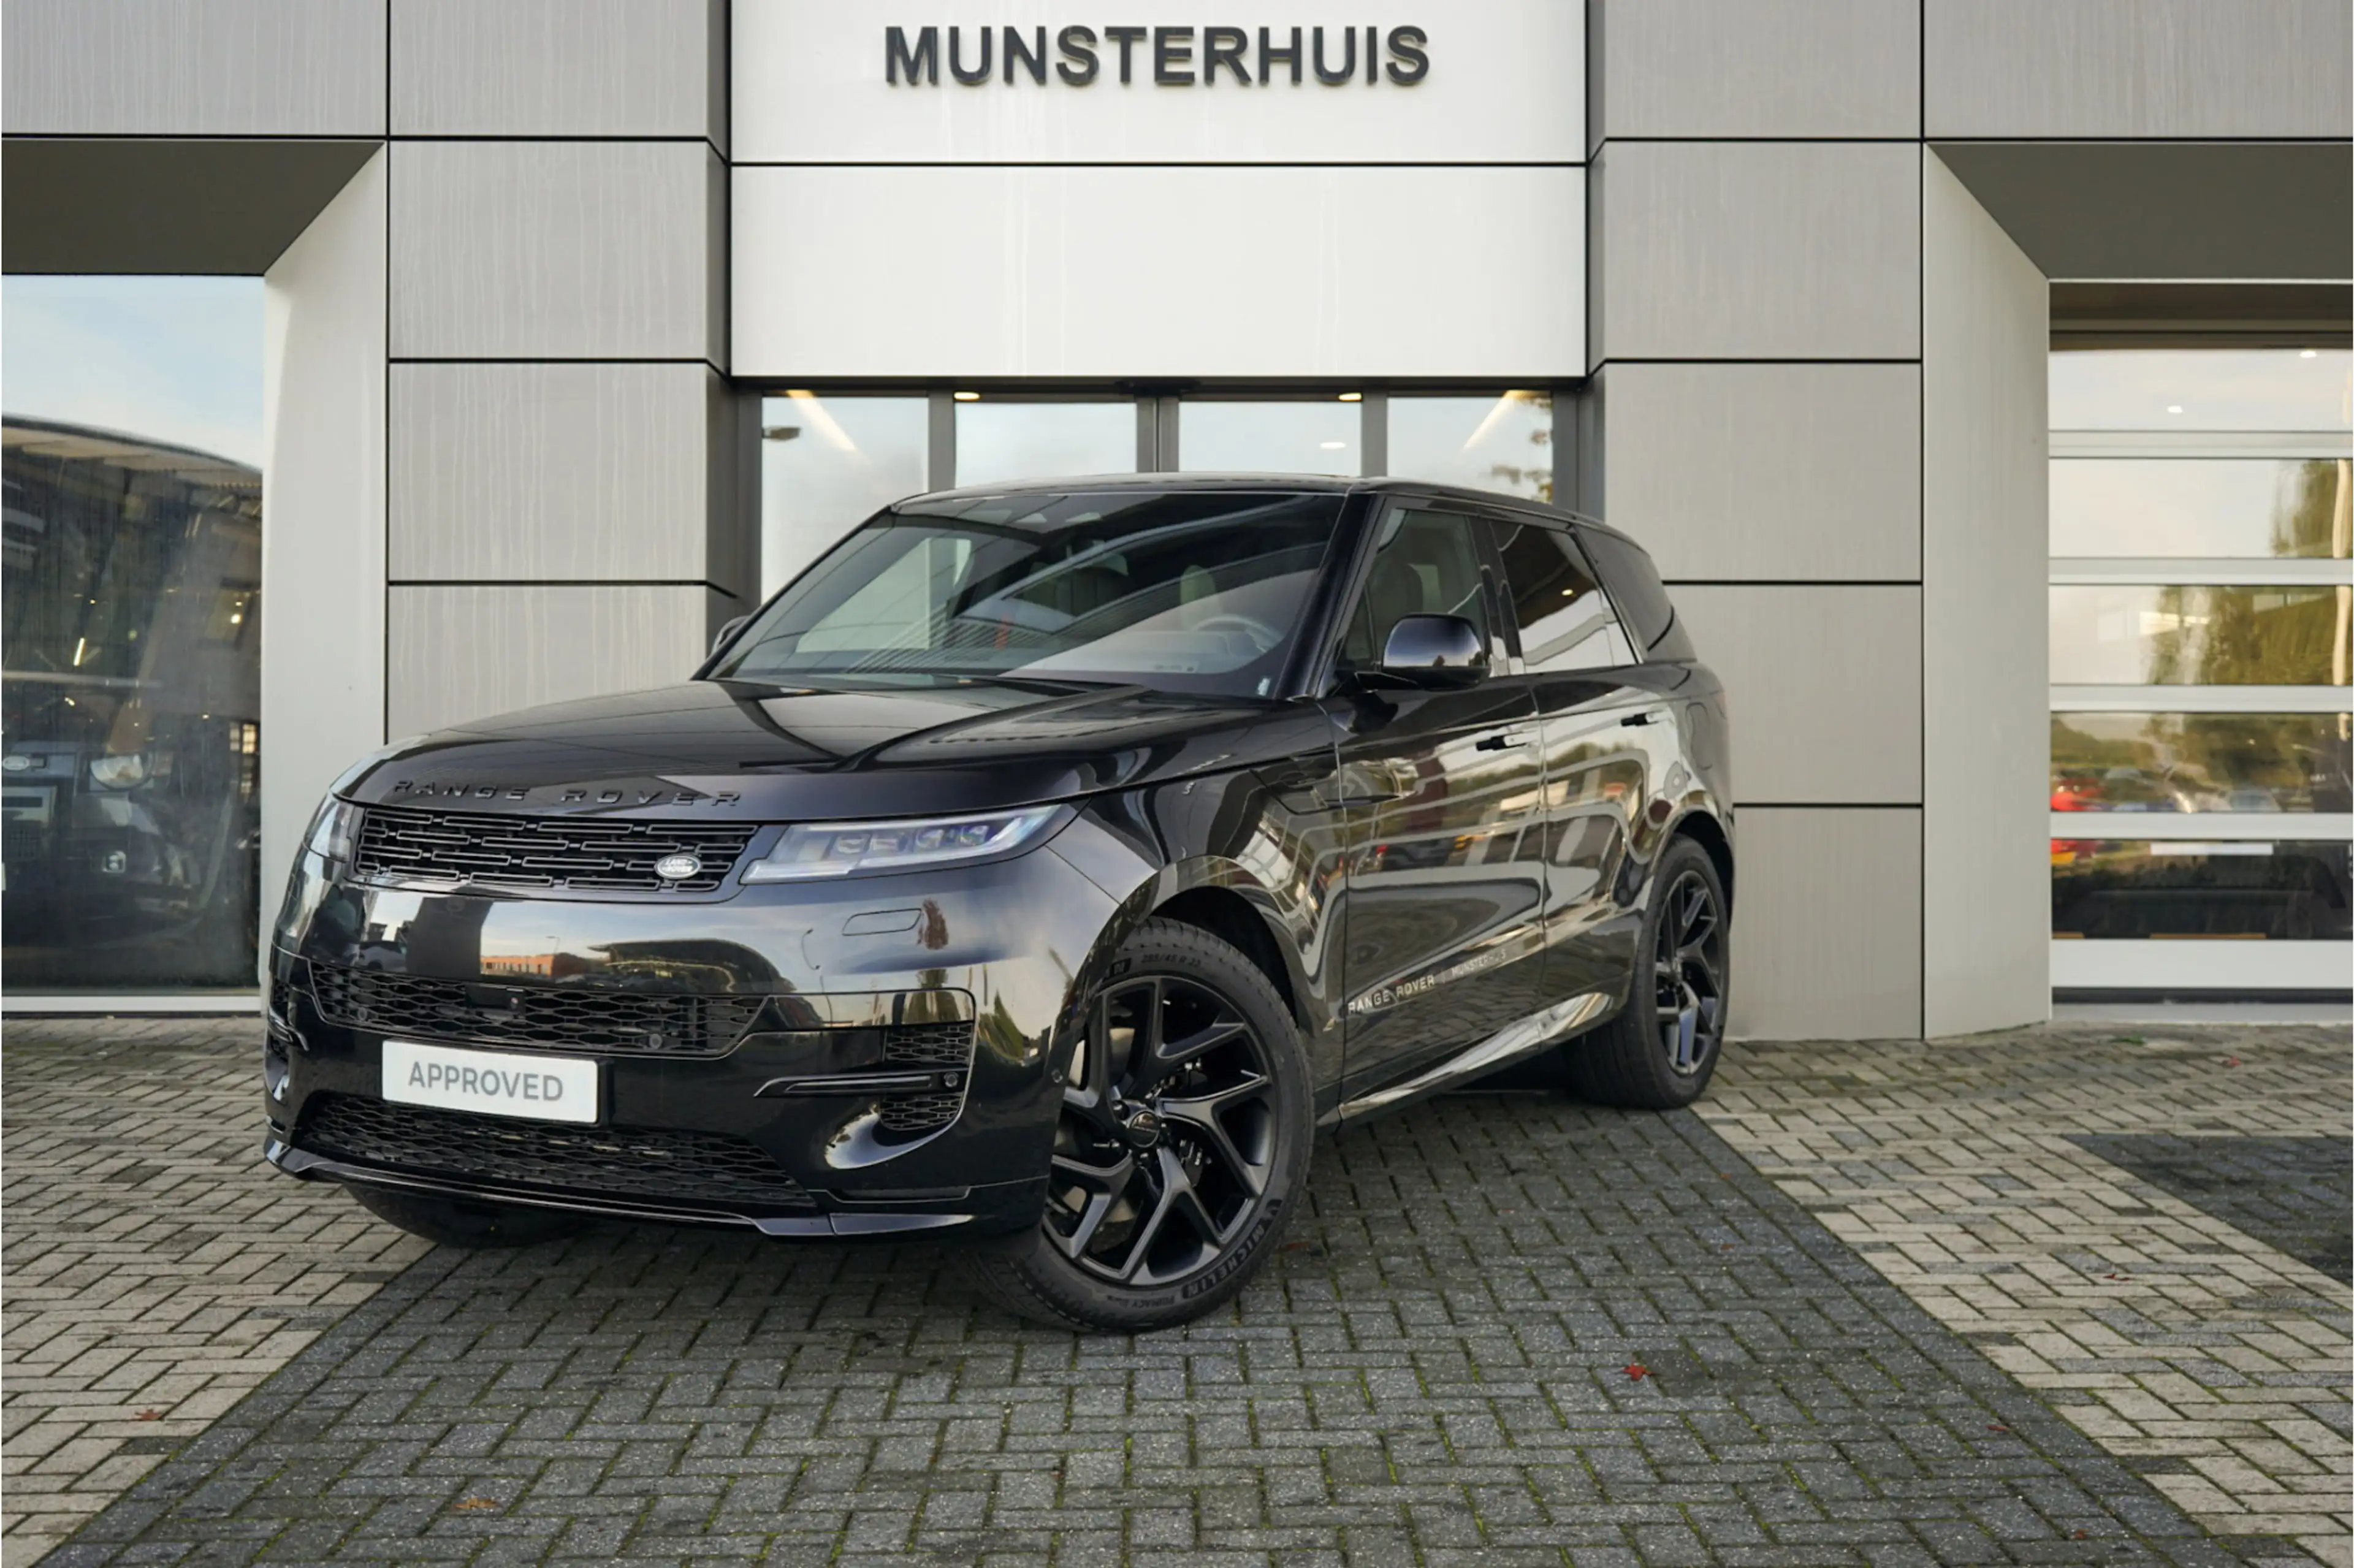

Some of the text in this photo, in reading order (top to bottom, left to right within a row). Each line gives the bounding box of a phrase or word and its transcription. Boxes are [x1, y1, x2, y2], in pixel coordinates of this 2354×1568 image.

[885, 25, 1430, 87] MUNSTERHUIS
[393, 779, 741, 807] RANGE ROVER
[1348, 949, 1506, 1014] RANGE ROVER MUNSTERS
[408, 1061, 563, 1102] APPROVED
[1188, 1224, 1265, 1296] MICHELIN
